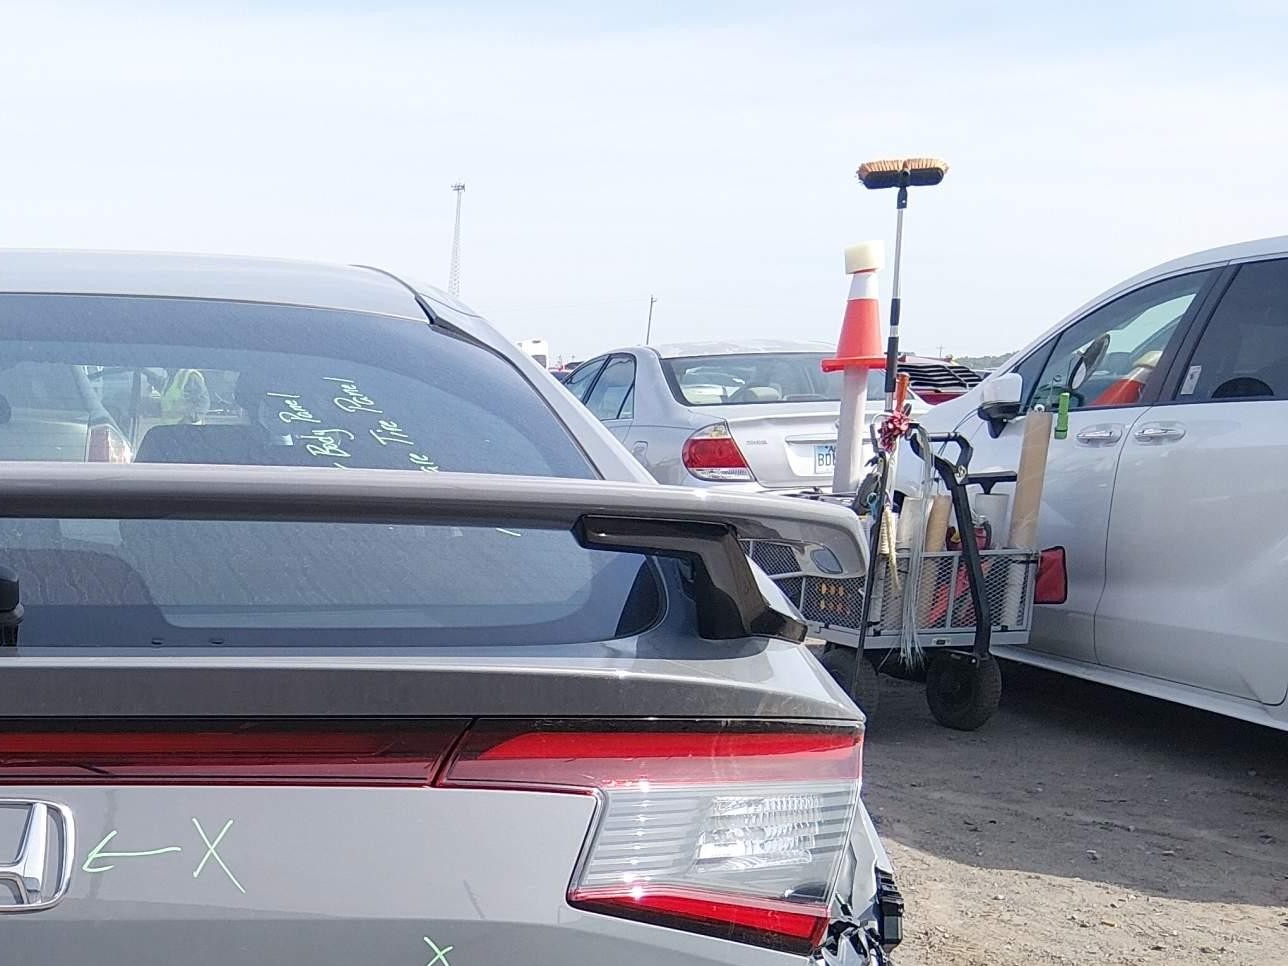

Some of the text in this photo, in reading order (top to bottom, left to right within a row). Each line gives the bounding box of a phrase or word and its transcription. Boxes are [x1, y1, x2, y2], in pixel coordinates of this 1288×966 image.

[322, 376, 383, 414] Panel
[267, 392, 355, 457] Body Panel
[369, 419, 414, 446] Tire
